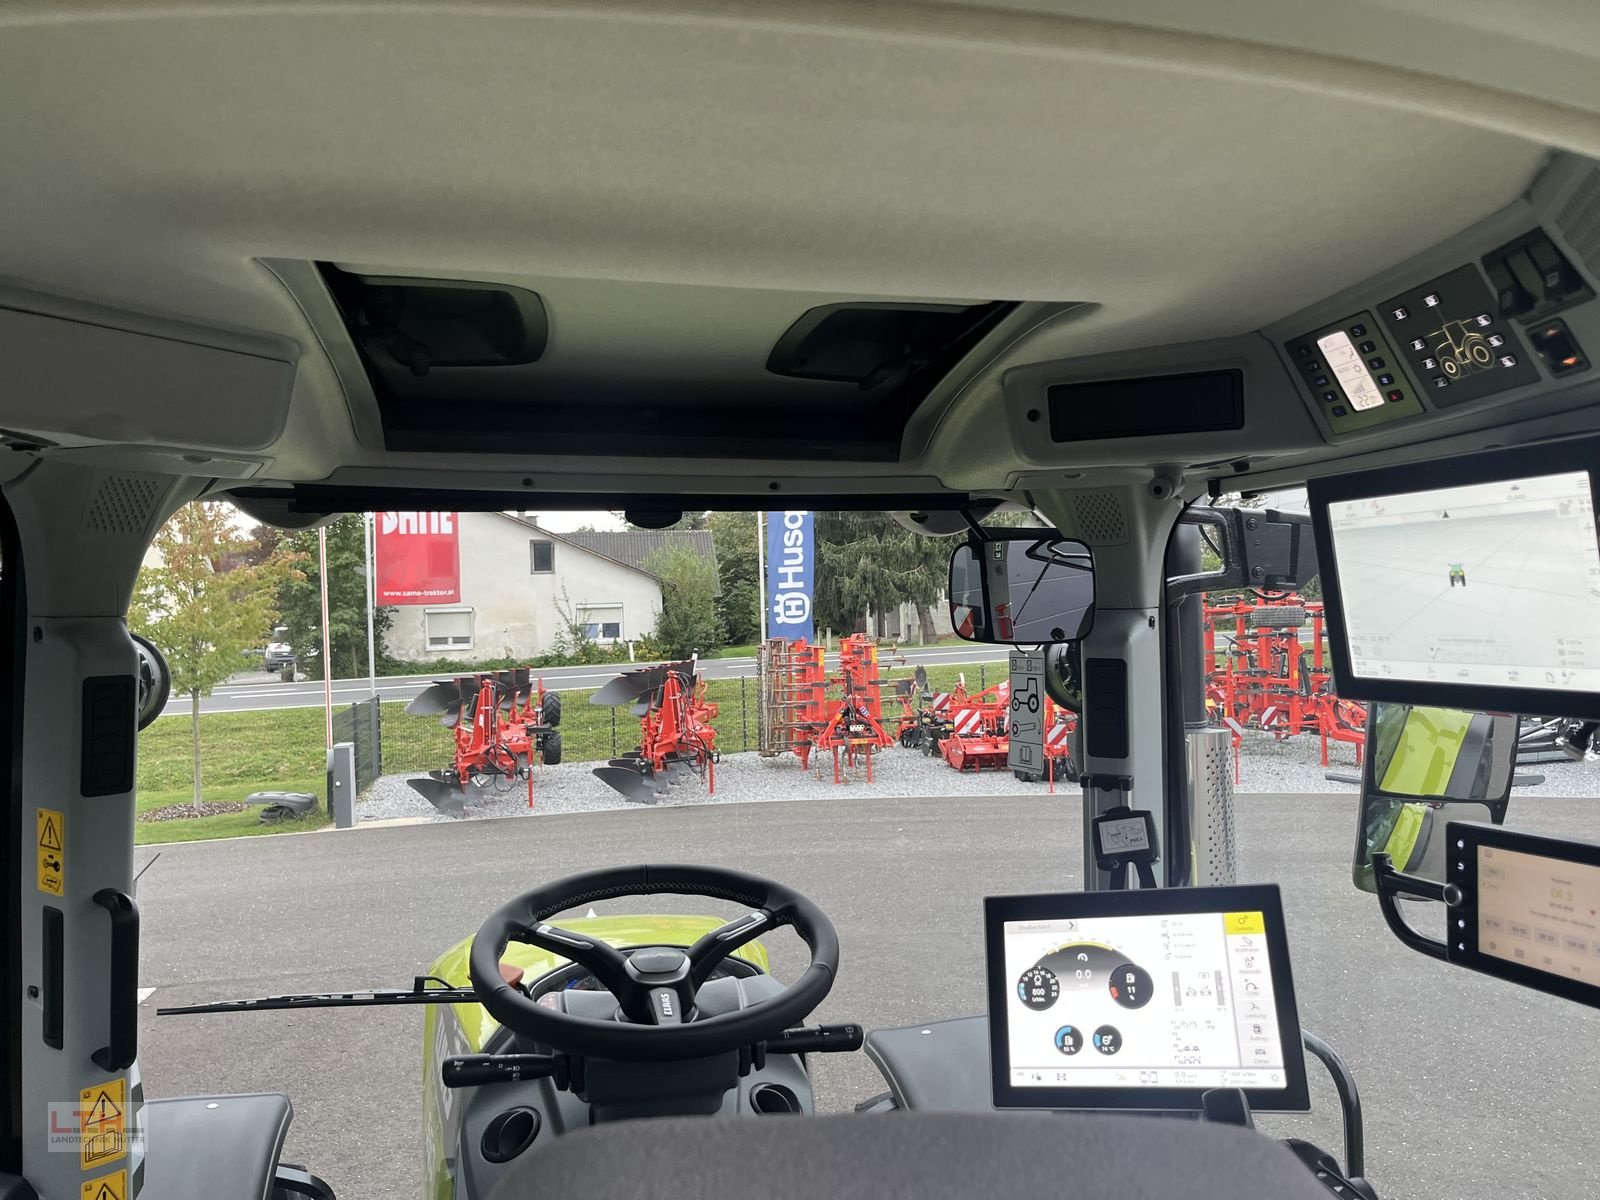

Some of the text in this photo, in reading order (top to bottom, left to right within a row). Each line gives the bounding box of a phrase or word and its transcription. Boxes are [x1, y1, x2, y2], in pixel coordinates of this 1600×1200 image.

[1075, 969, 1092, 980] 0.0
[1032, 988, 1045, 996] 800
[1127, 986, 1136, 994] 11
[660, 993, 673, 1016] CLAAS
